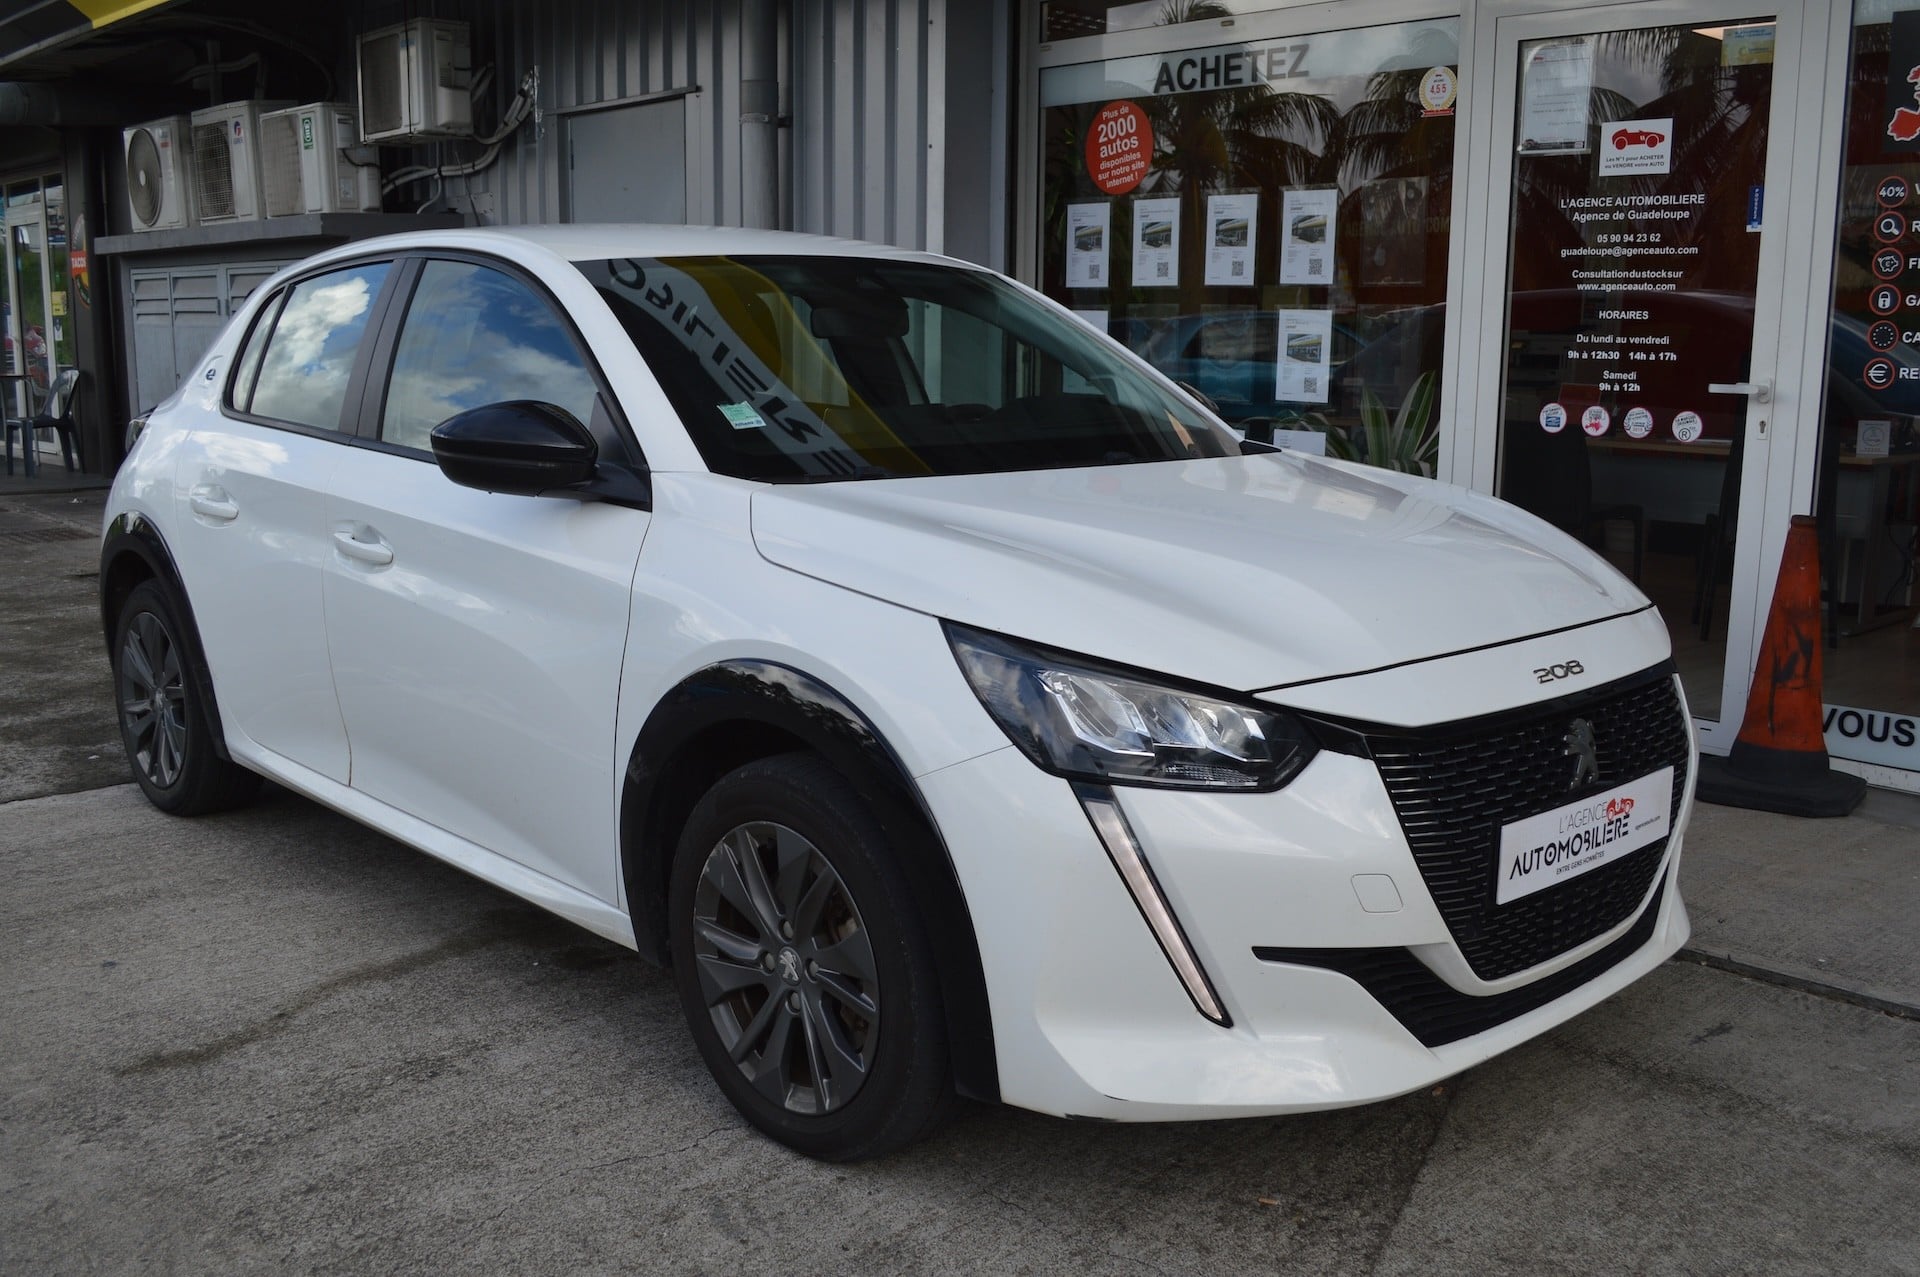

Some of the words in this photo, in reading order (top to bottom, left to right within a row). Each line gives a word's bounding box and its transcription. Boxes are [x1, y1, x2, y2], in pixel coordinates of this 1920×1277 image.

[1153, 44, 1310, 94] ACHETEZ
[1102, 109, 1119, 120] Plus
[1119, 105, 1129, 114] de
[1097, 114, 1137, 143] 2000
[1099, 136, 1139, 158] autos
[1100, 152, 1142, 170] disponibles
[1098, 171, 1110, 181] sur
[1111, 165, 1130, 177] notre
[1131, 161, 1145, 170] site
[1106, 174, 1134, 188] internet
[1879, 186, 1905, 197] 40%
[1560, 197, 1613, 208] L'AGENCE
[1614, 194, 1706, 206] AUTOMOBILIERE
[1572, 211, 1610, 223] Agence
[1612, 211, 1625, 220] de
[1627, 209, 1690, 221] Guadeloupe
[1597, 234, 1608, 243] 05
[1610, 234, 1621, 243] 90
[1623, 234, 1634, 243] 94
[1636, 233, 1648, 242] 23
[1649, 233, 1661, 242] 62
[1560, 246, 1699, 258] guadeloupe@agenceauto.com
[71, 257, 87, 268] TACOS
[1576, 282, 1676, 293] www.agenceauto.com
[1598, 310, 1649, 320] HORAIRES
[1576, 334, 1589, 343] Du
[1590, 334, 1614, 343] lundi
[1616, 336, 1627, 344] au
[1629, 335, 1670, 345] vendredi
[1567, 351, 1580, 360] 9h
[1582, 351, 1588, 359] à
[1590, 351, 1620, 360] 12h30
[1628, 352, 1646, 360] 14h
[1649, 352, 1656, 360] à
[1658, 352, 1677, 361] 17h
[205, 368, 217, 381] e
[1602, 370, 1637, 380] Samedi
[1899, 367, 1920, 379] RE
[1598, 383, 1611, 391] 9h
[1613, 383, 1620, 391] à
[1622, 383, 1641, 391] 12h
[1533, 660, 1584, 684] 208
[1823, 708, 1916, 747] VOUS
[1558, 801, 1608, 834] L'AGENCE
[1556, 864, 1571, 875] ENTRE
[1571, 858, 1583, 869] GENS
